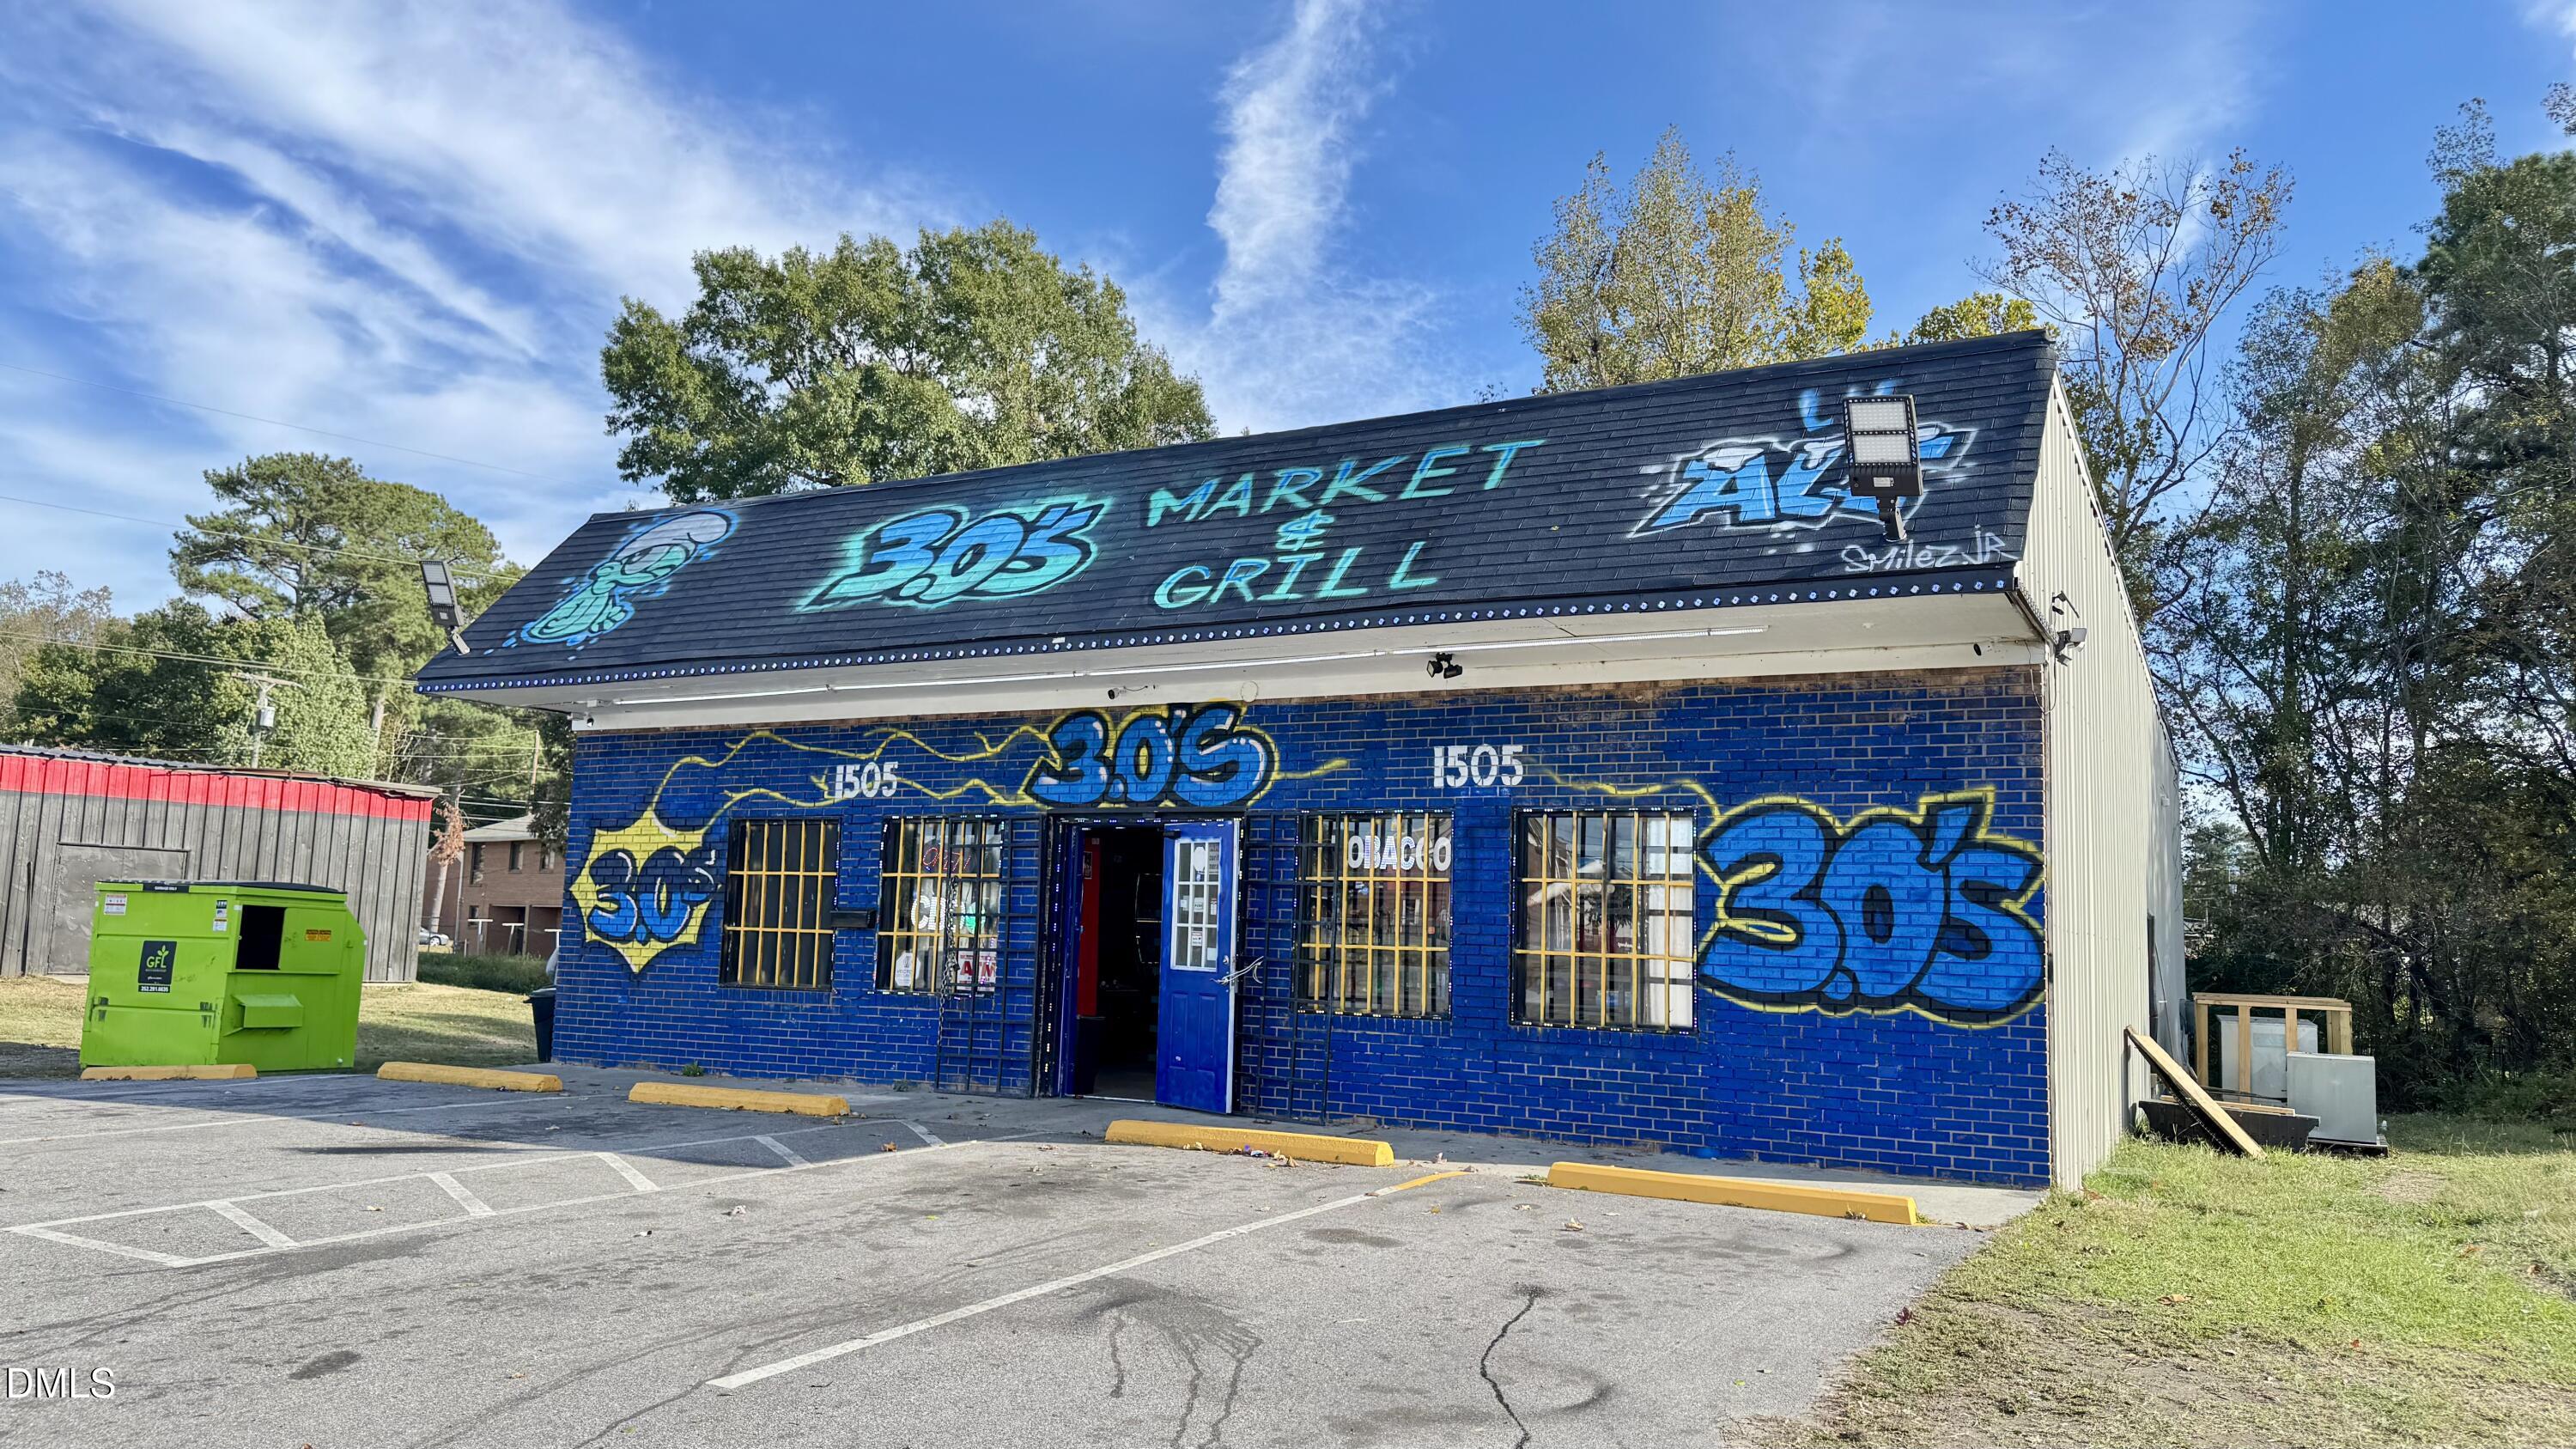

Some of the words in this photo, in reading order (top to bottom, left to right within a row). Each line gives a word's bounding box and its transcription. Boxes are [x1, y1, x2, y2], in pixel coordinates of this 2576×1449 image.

[1147, 440, 1546, 527] MARKET
[1274, 508, 1335, 551] &
[1154, 541, 1438, 609] GRILL
[835, 761, 898, 799] 1505
[1432, 744, 1524, 788] 1505
[1332, 835, 1452, 872] OBACCO
[146, 955, 167, 968] GFL
